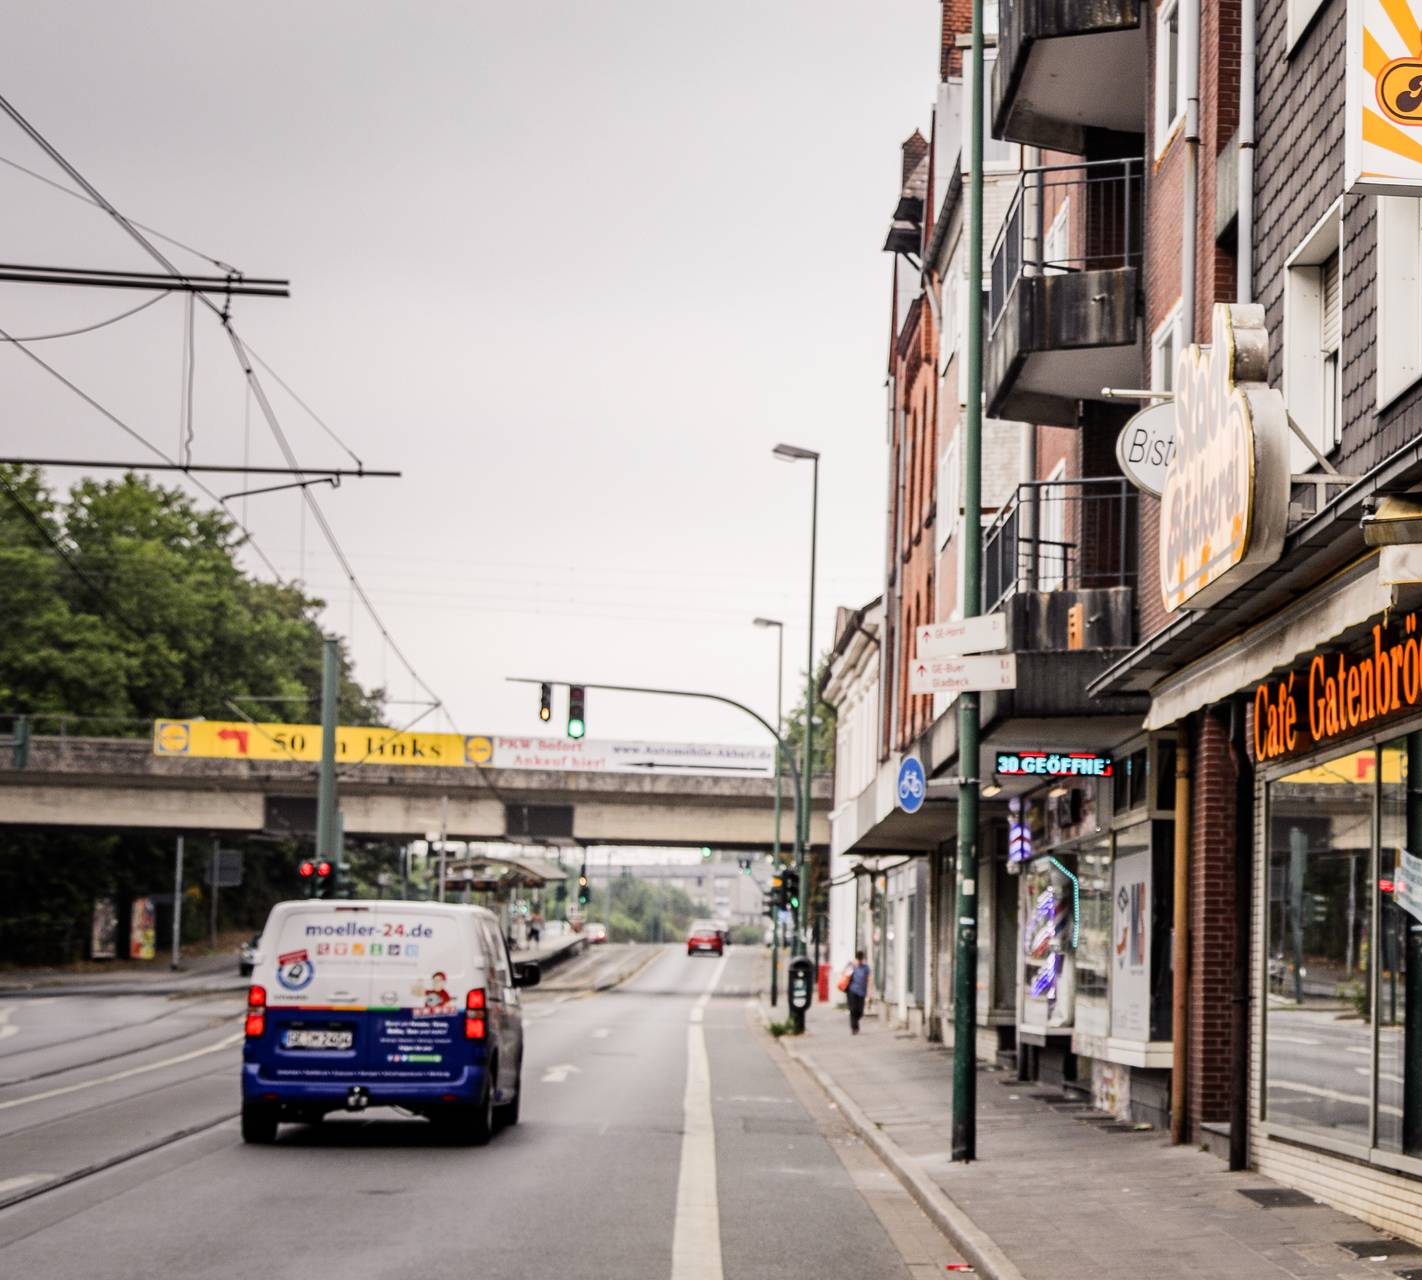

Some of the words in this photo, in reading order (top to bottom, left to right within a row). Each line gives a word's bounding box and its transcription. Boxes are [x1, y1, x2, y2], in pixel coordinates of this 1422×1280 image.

[1177, 316, 1230, 474] Stadt
[1129, 428, 1175, 467] Bist
[1167, 426, 1241, 581] Bäckerei
[1253, 671, 1297, 762] Café
[272, 733, 305, 752] 50
[367, 736, 442, 757] links
[1021, 754, 1111, 775] GEÖFFNE
[305, 922, 433, 939] moeller-24.de
